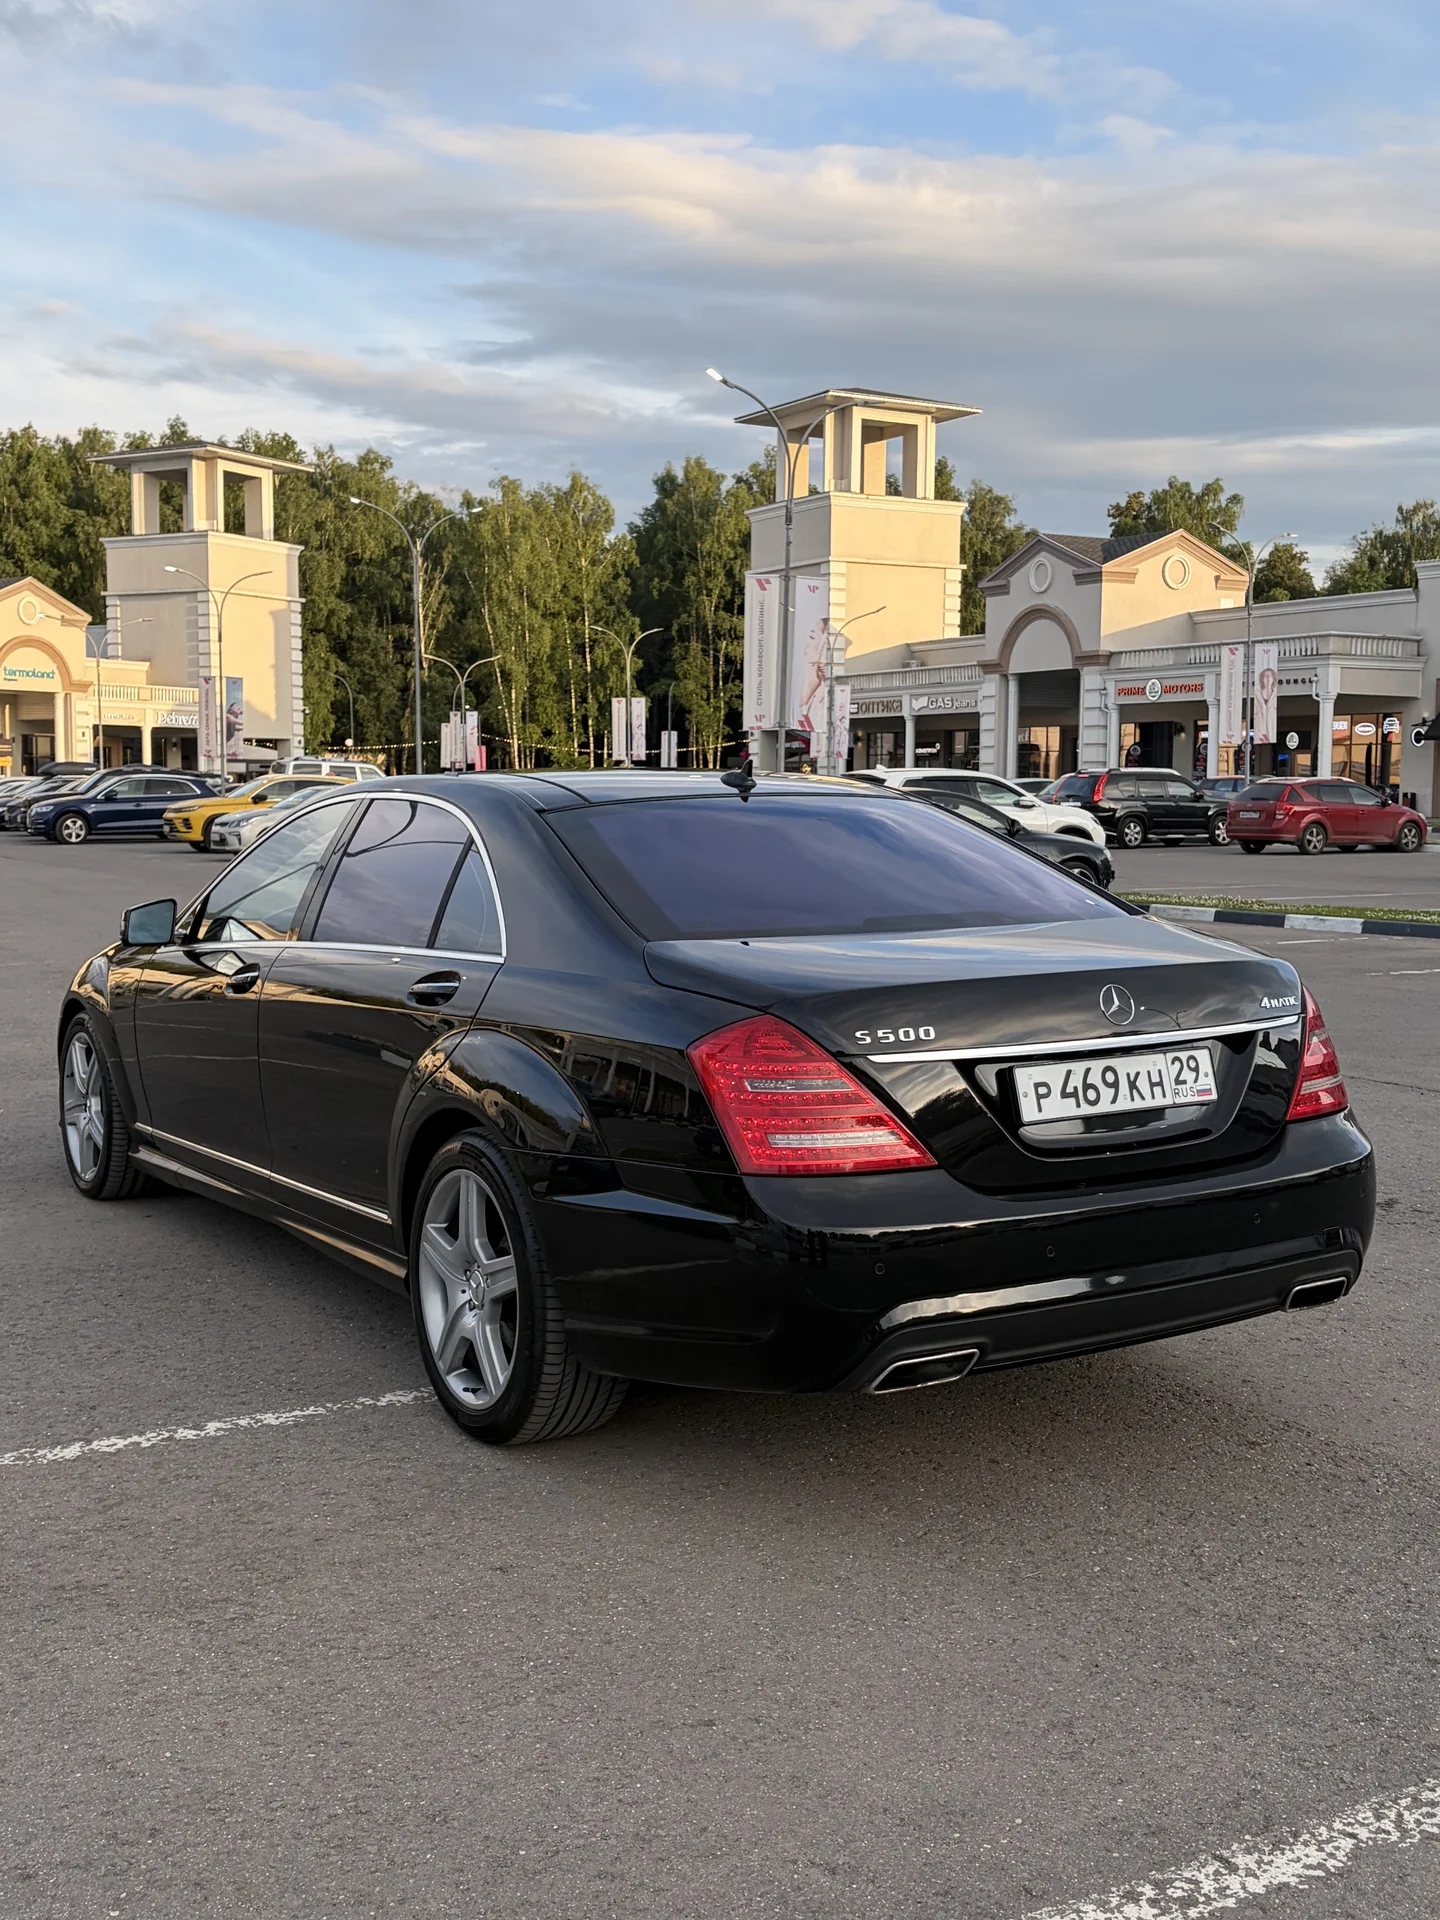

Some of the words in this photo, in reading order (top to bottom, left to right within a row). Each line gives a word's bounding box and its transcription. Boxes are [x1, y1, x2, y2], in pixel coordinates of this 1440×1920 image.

[3, 666, 55, 679] termoland
[1117, 686, 1146, 696] PRIME
[1163, 682, 1204, 694] MOTORS
[928, 697, 952, 709] GAS
[954, 699, 976, 709] jeans
[854, 1030, 872, 1045] S
[876, 1026, 936, 1043] 500
[1171, 1054, 1201, 1086] 29
[1174, 1086, 1196, 1099] RUS
